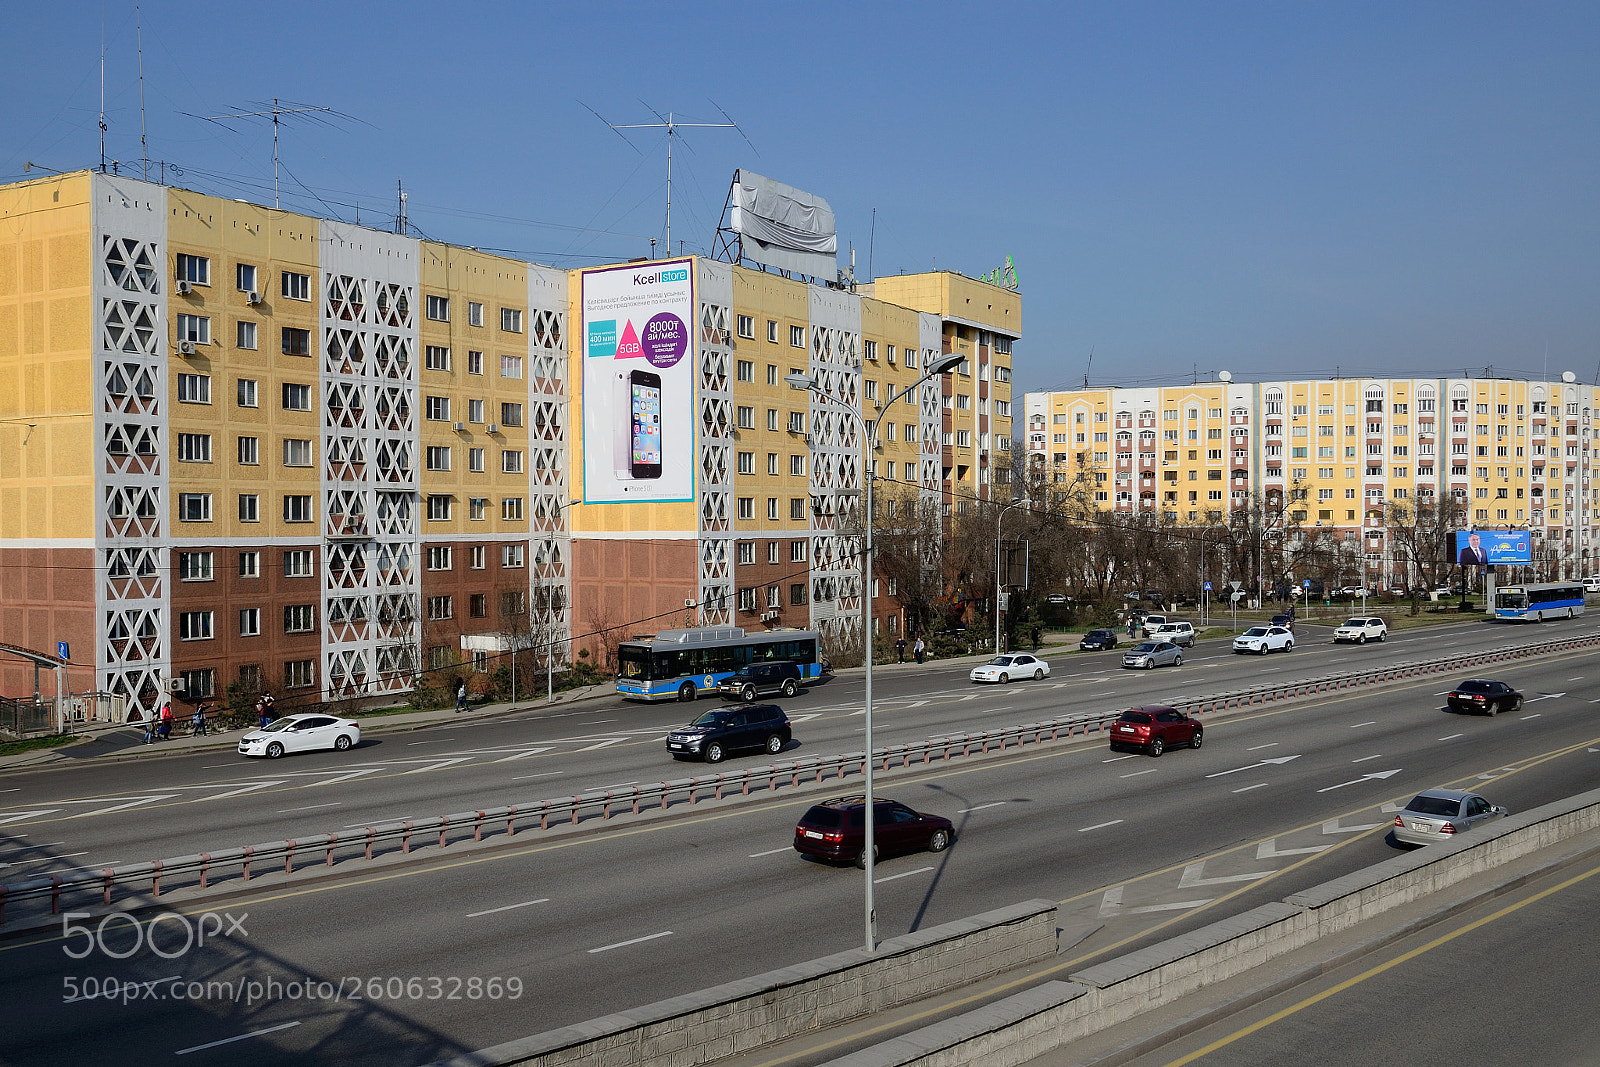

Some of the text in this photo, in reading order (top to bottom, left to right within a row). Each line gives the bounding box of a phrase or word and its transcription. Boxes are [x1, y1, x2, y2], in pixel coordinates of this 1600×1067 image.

[633, 271, 686, 286] Kcell store
[587, 303, 613, 312] Выгодное
[613, 300, 650, 310] предложение
[659, 296, 688, 304] контракту
[589, 335, 602, 343] 400
[619, 343, 640, 354] 5GB
